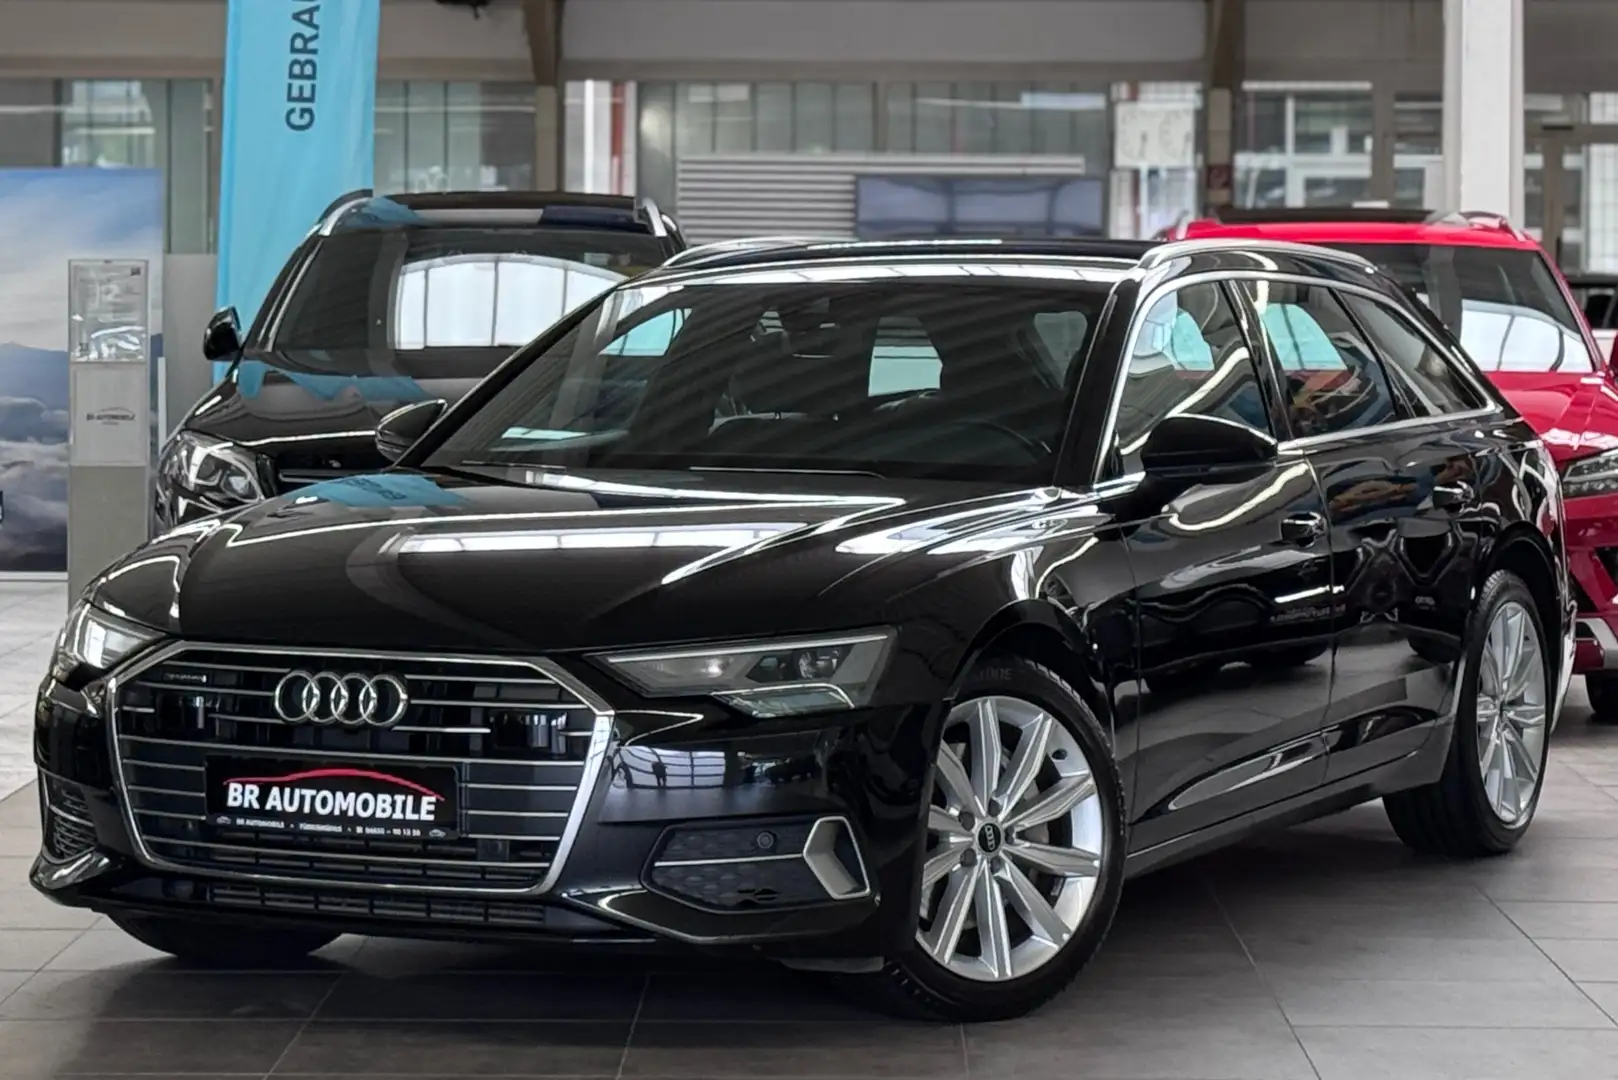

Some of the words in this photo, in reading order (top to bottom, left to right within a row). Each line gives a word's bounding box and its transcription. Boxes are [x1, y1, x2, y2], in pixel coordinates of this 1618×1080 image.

[285, 0, 320, 131] GEBRA
[226, 782, 261, 809] BR
[264, 786, 436, 821] AUTOMOBILE
